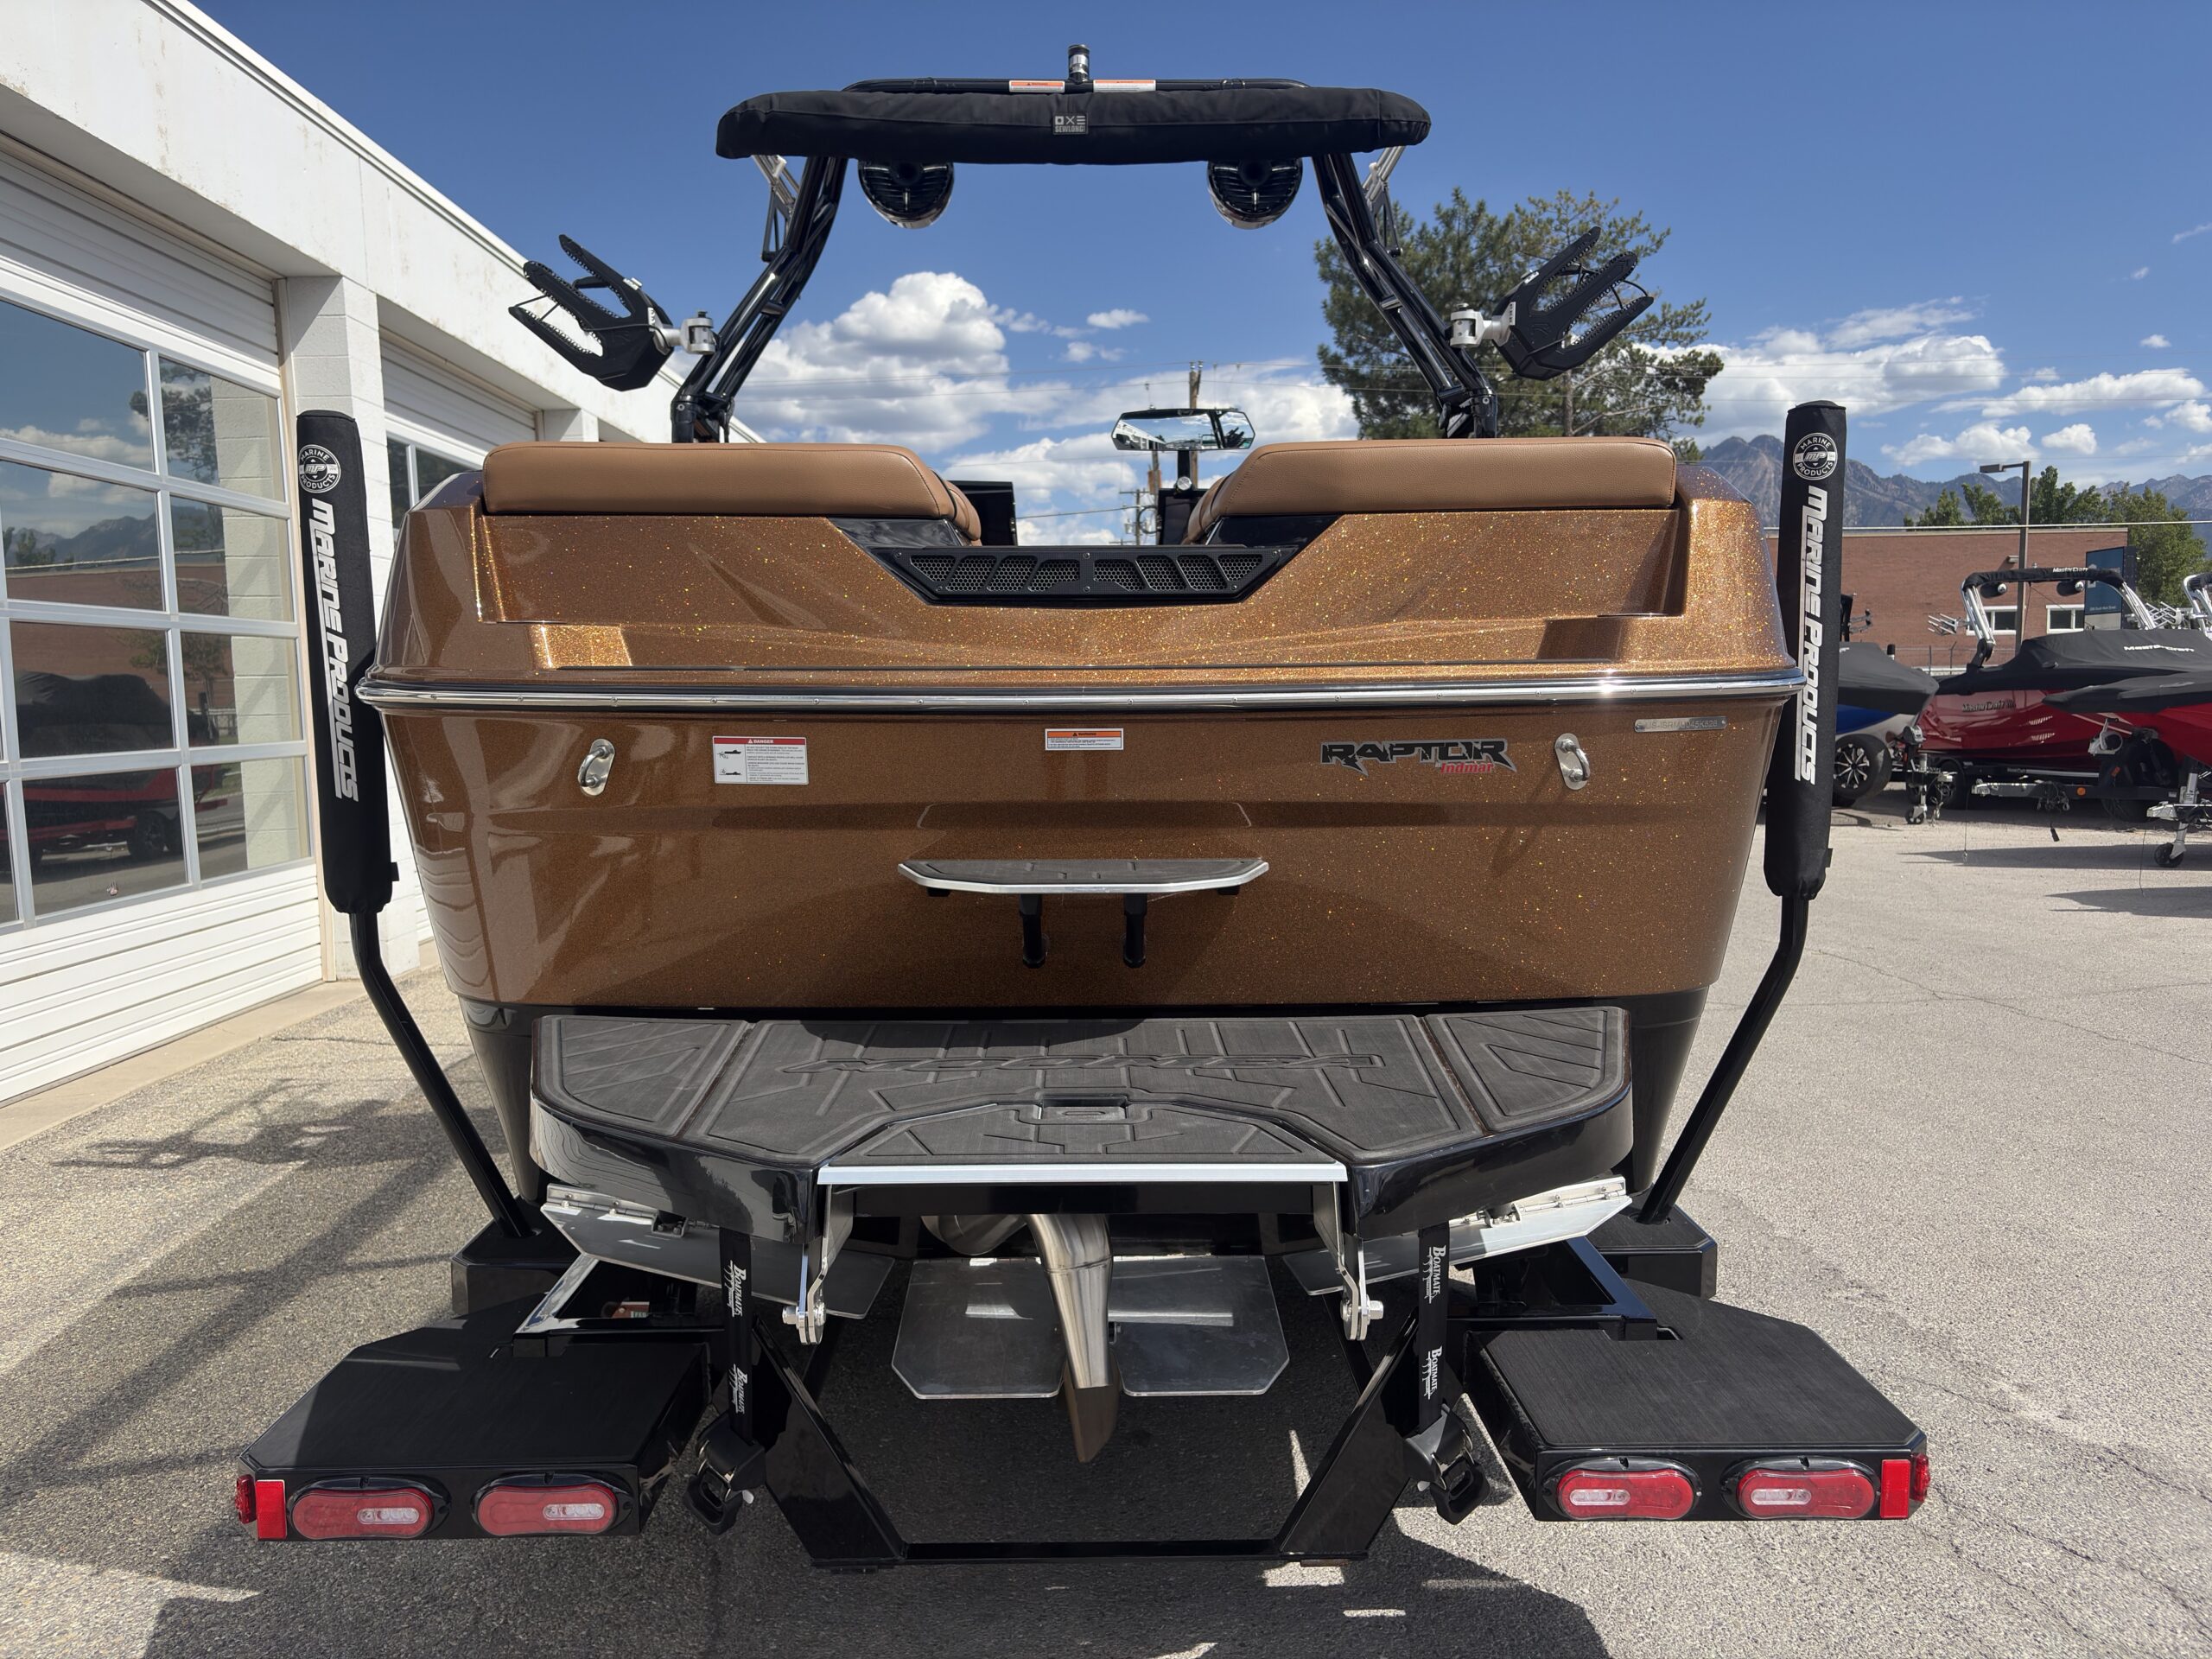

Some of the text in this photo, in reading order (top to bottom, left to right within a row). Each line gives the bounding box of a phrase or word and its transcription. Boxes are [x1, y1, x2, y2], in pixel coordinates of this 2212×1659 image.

[1801, 437, 1832, 449] MARINE
[301, 449, 330, 461] MARINE
[1797, 461, 1834, 476] PRODUCTS
[302, 474, 336, 489] PRODUCTS
[1801, 486, 1827, 785] MARINE PRODUCTS
[309, 498, 359, 803] MARINE PRODUCTS
[1320, 739, 1517, 776] RAPTOR
[1440, 762, 1494, 774] Indmar
